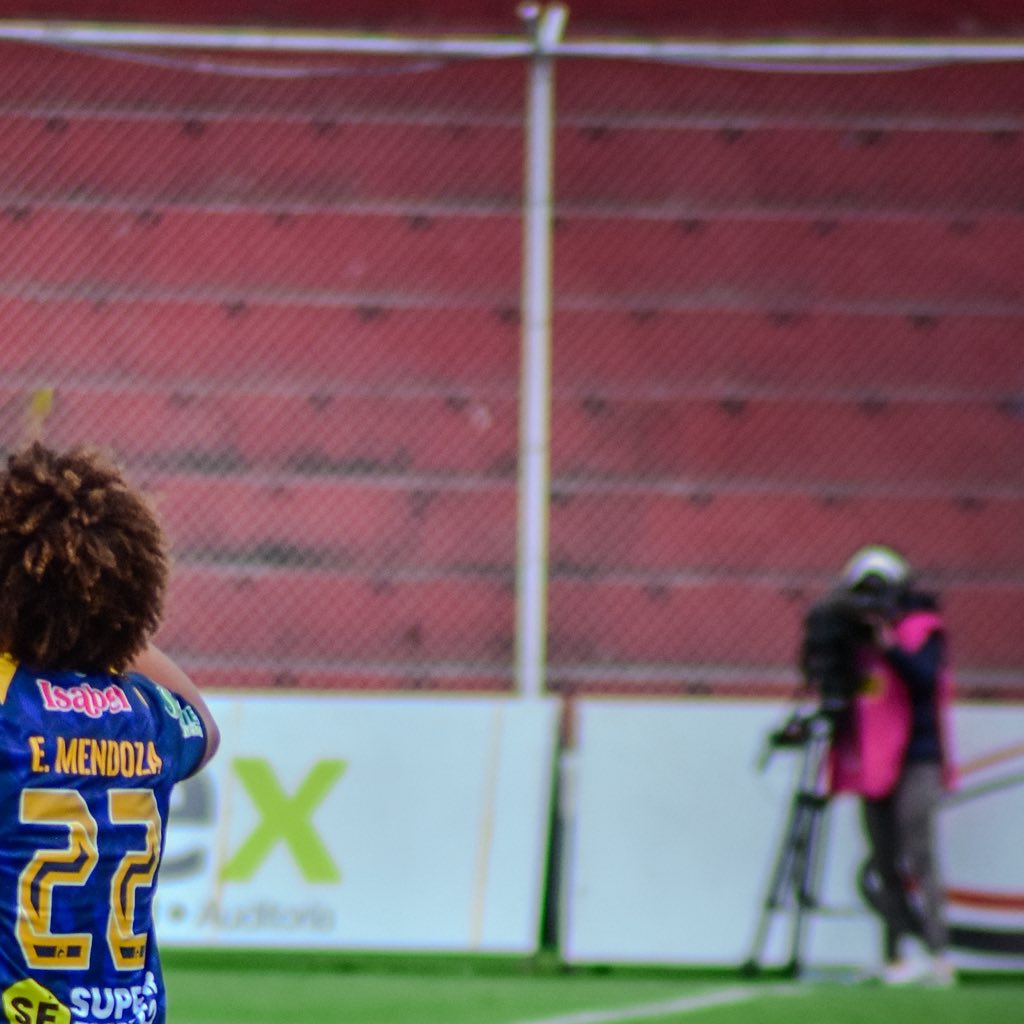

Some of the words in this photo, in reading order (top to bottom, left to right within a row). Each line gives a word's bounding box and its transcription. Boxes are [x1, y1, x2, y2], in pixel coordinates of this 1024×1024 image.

[36, 679, 132, 718] Isabel
[29, 736, 50, 773] E.
[55, 736, 163, 778] MENDOZA
[15, 788, 162, 971] 22
[70, 977, 157, 1022] SUPE
